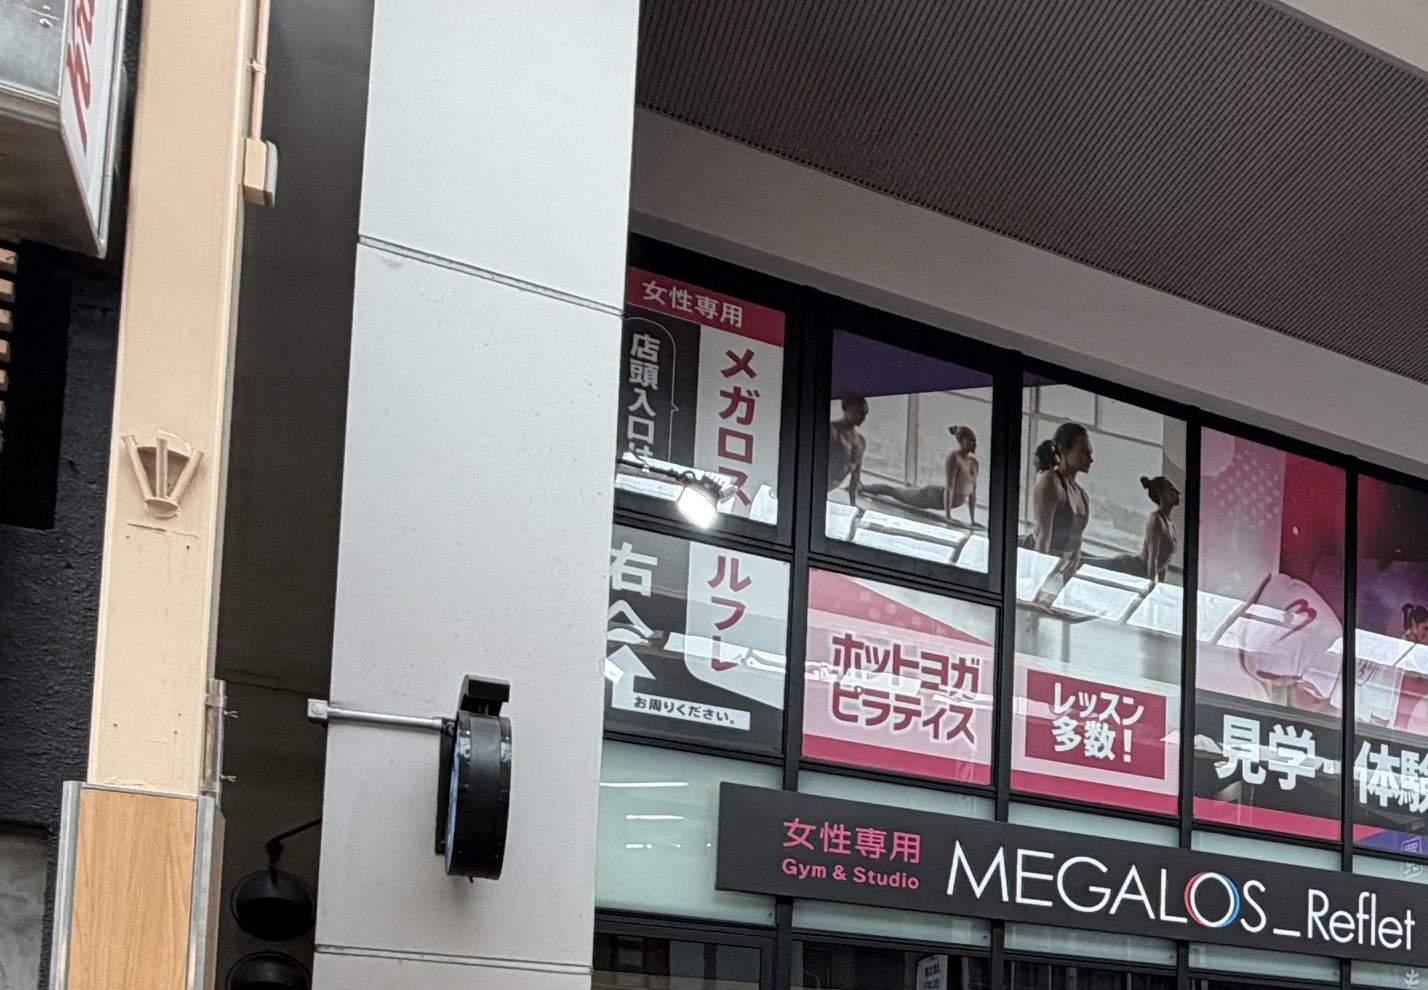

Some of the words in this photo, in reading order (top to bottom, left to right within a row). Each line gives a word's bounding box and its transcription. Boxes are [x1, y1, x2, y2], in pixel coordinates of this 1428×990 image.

[641, 280, 743, 328] 女性専用
[717, 348, 761, 506] メガロス
[707, 555, 752, 672] ルフレ
[831, 633, 980, 695] ホットヨガ
[831, 685, 976, 746] ピラティス
[1052, 681, 1145, 727] レッスン
[1051, 716, 1133, 763] 多数!
[782, 817, 921, 864] 女性専用
[782, 857, 826, 881] Gym
[832, 864, 848, 881] &
[853, 866, 919, 890] Studio
